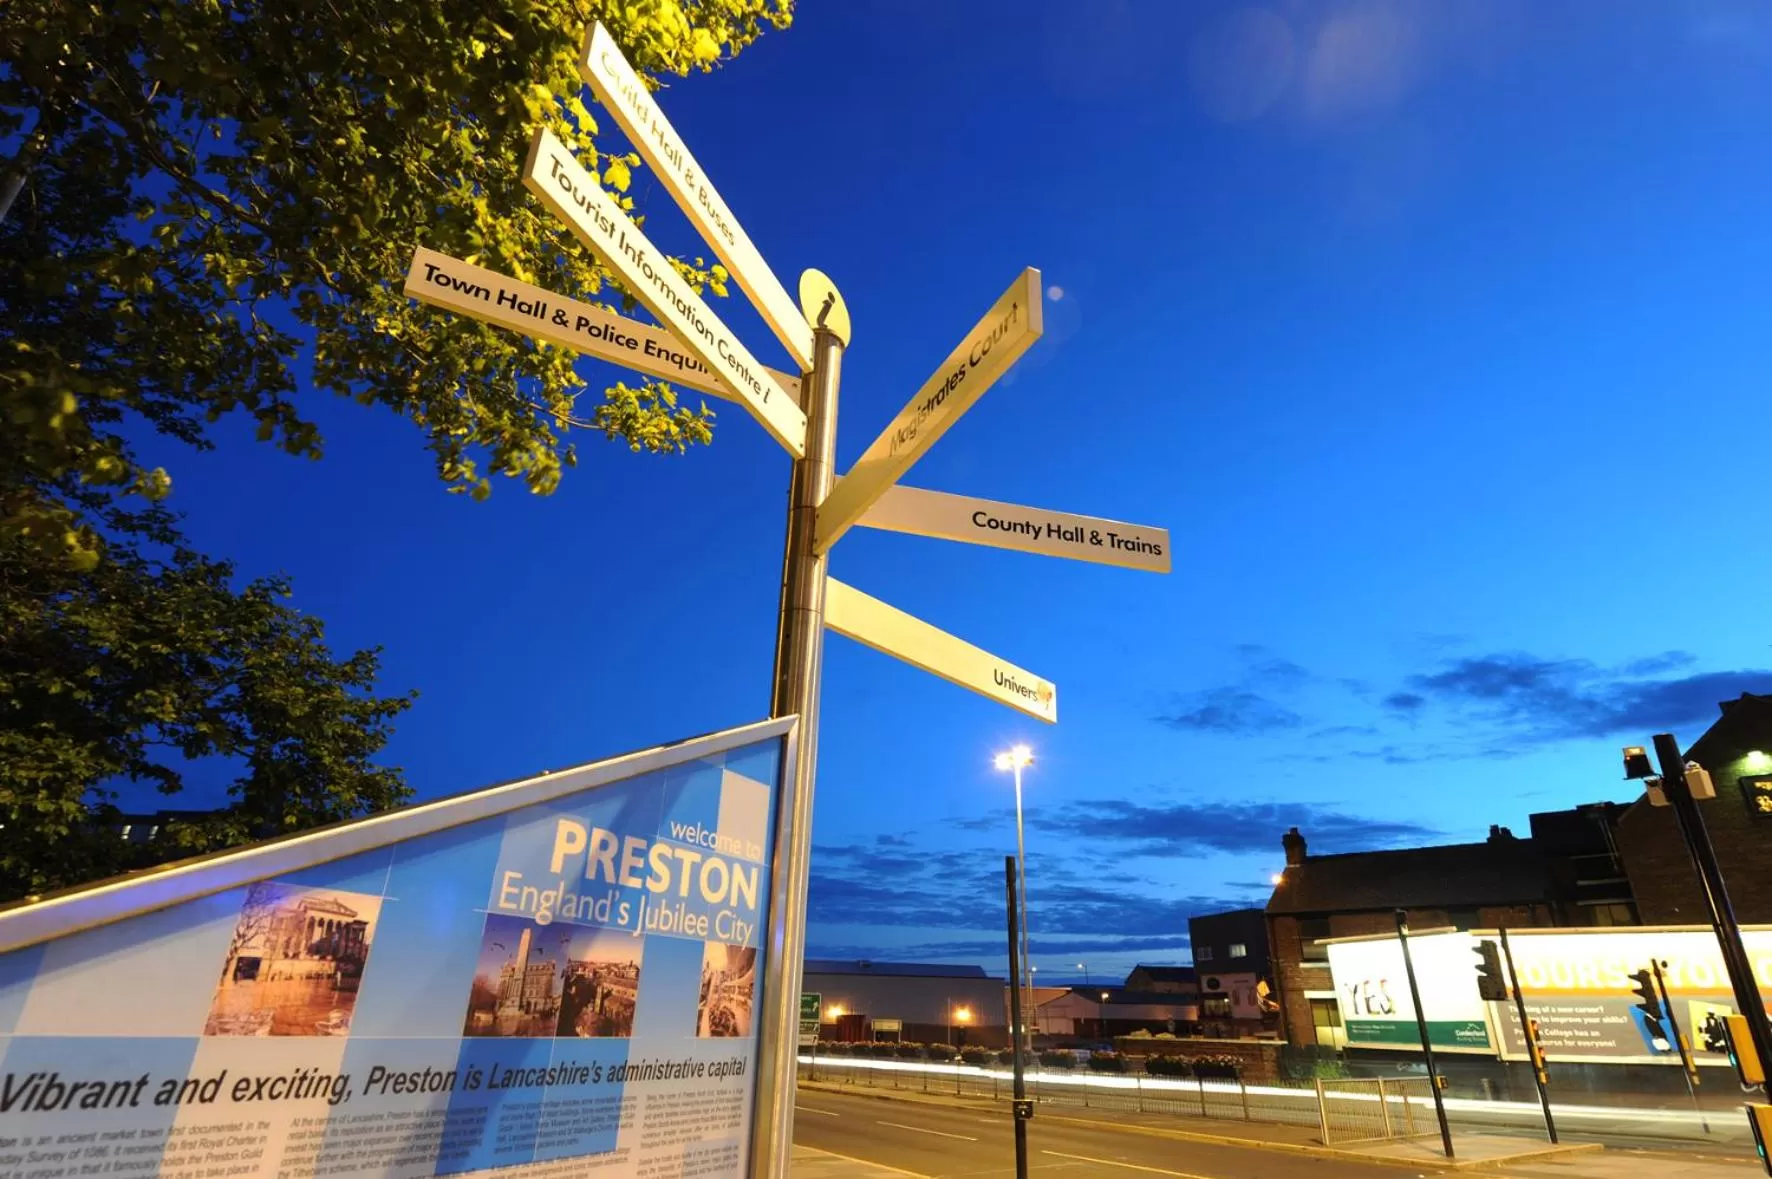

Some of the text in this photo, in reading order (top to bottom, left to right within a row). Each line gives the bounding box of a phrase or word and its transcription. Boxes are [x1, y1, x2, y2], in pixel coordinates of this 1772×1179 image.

[651, 120, 683, 172] Hall
[684, 168, 695, 190] &
[698, 186, 735, 246] Buses
[550, 153, 616, 239] Tourist
[619, 230, 715, 346] Information
[717, 338, 762, 395] Centre
[424, 263, 719, 383] Town Hall & Police Enqui
[888, 301, 1019, 458] Magistrates Court
[971, 511, 1163, 556] County Hall & Trains
[993, 668, 1053, 711] Universy
[550, 819, 759, 911] PRESTON
[670, 820, 761, 859] welcome to
[497, 870, 754, 950] England's Jubilee City
[1344, 979, 1396, 1015] YES
[1508, 1004, 1542, 1015] Thking
[0, 1055, 748, 1113] Vibrant and exciting, Preston is Lancashire's administrative capital
